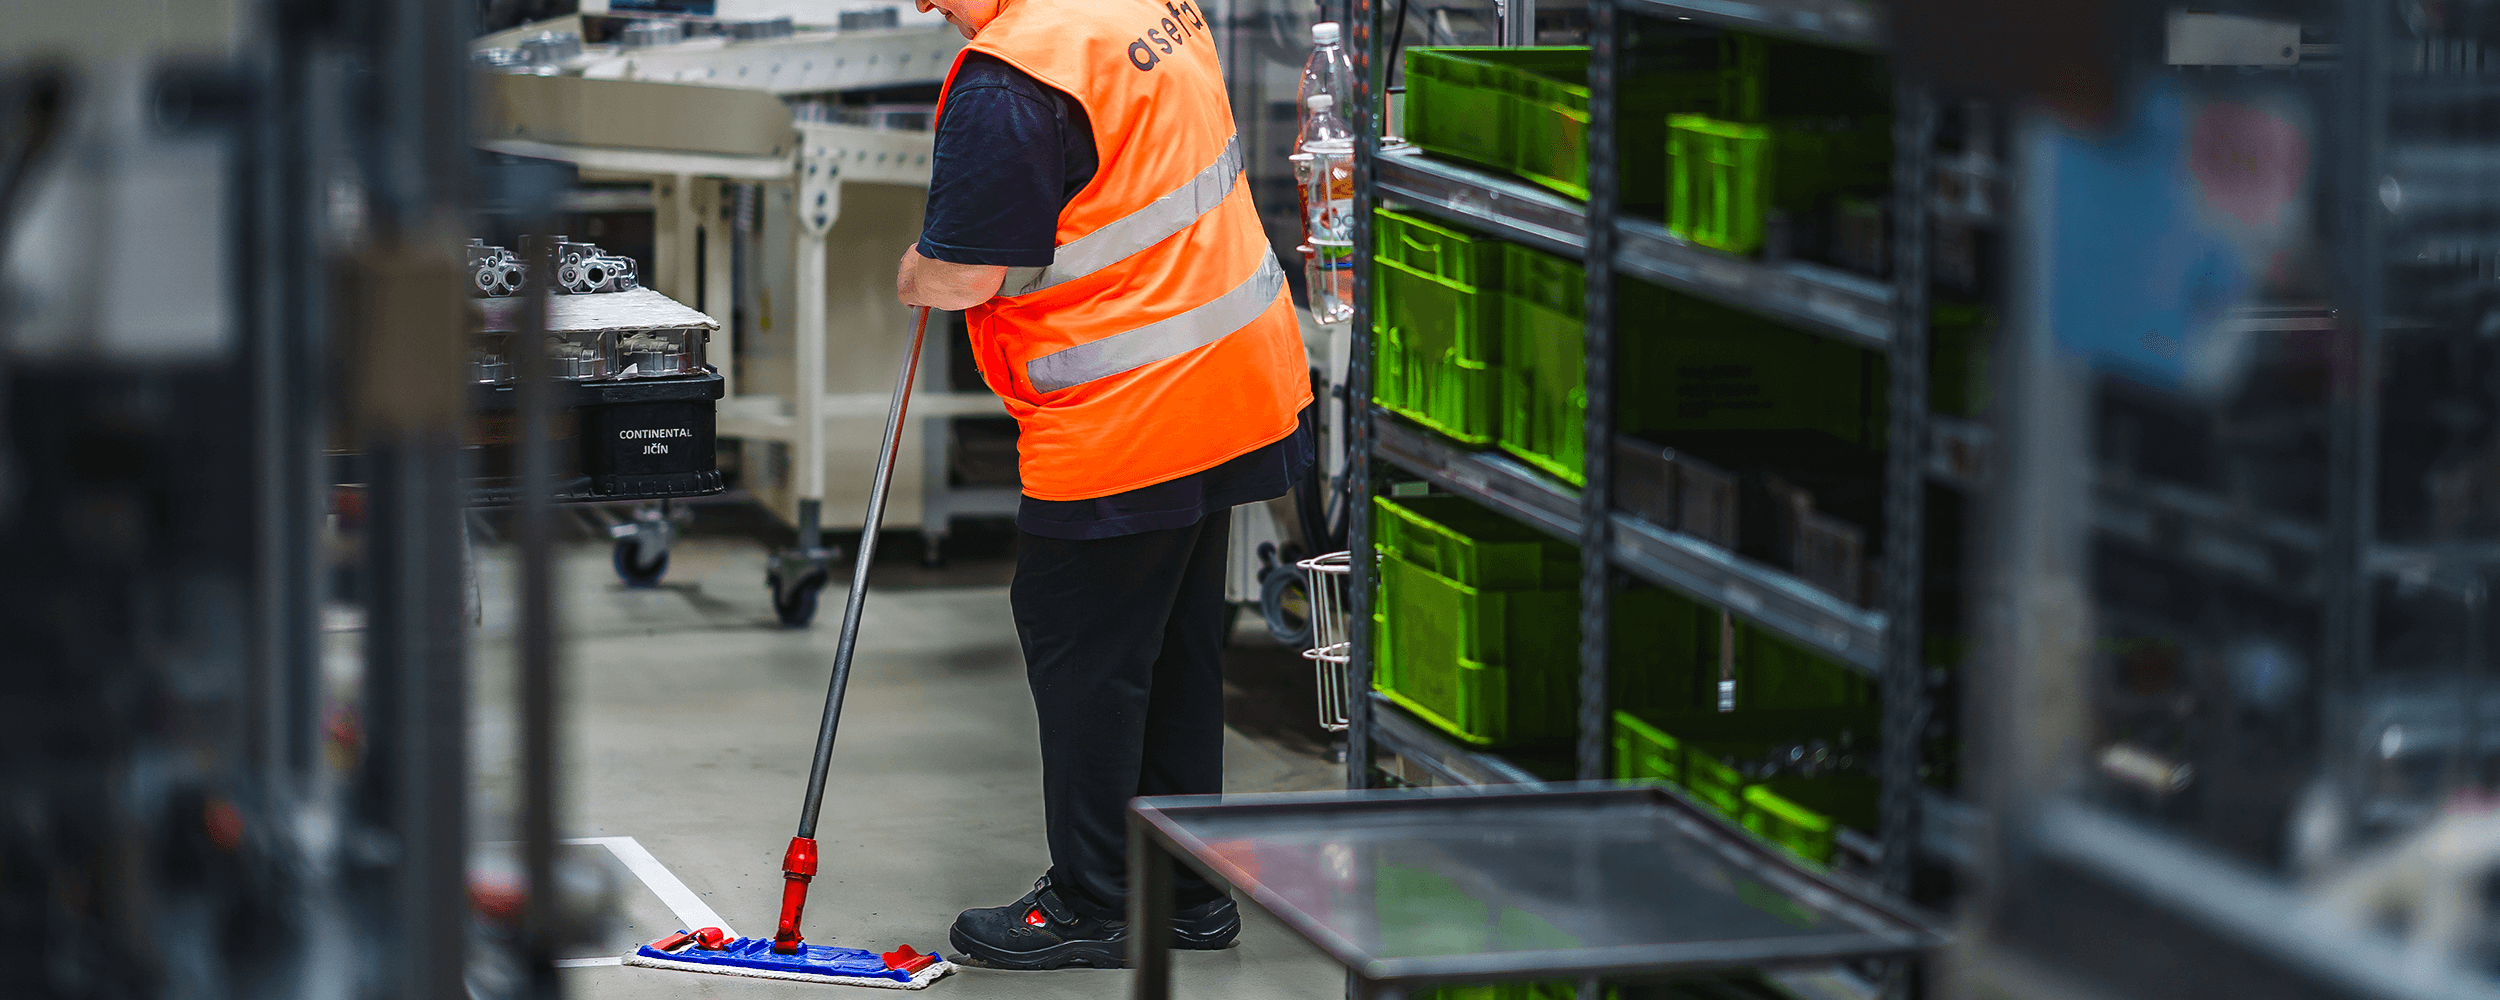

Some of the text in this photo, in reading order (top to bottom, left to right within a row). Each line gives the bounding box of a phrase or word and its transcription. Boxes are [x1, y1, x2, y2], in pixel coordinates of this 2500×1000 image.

[1127, 1, 1204, 72] aseta
[619, 428, 693, 440] CONTINENTAL
[643, 442, 669, 455] JIČÍN
